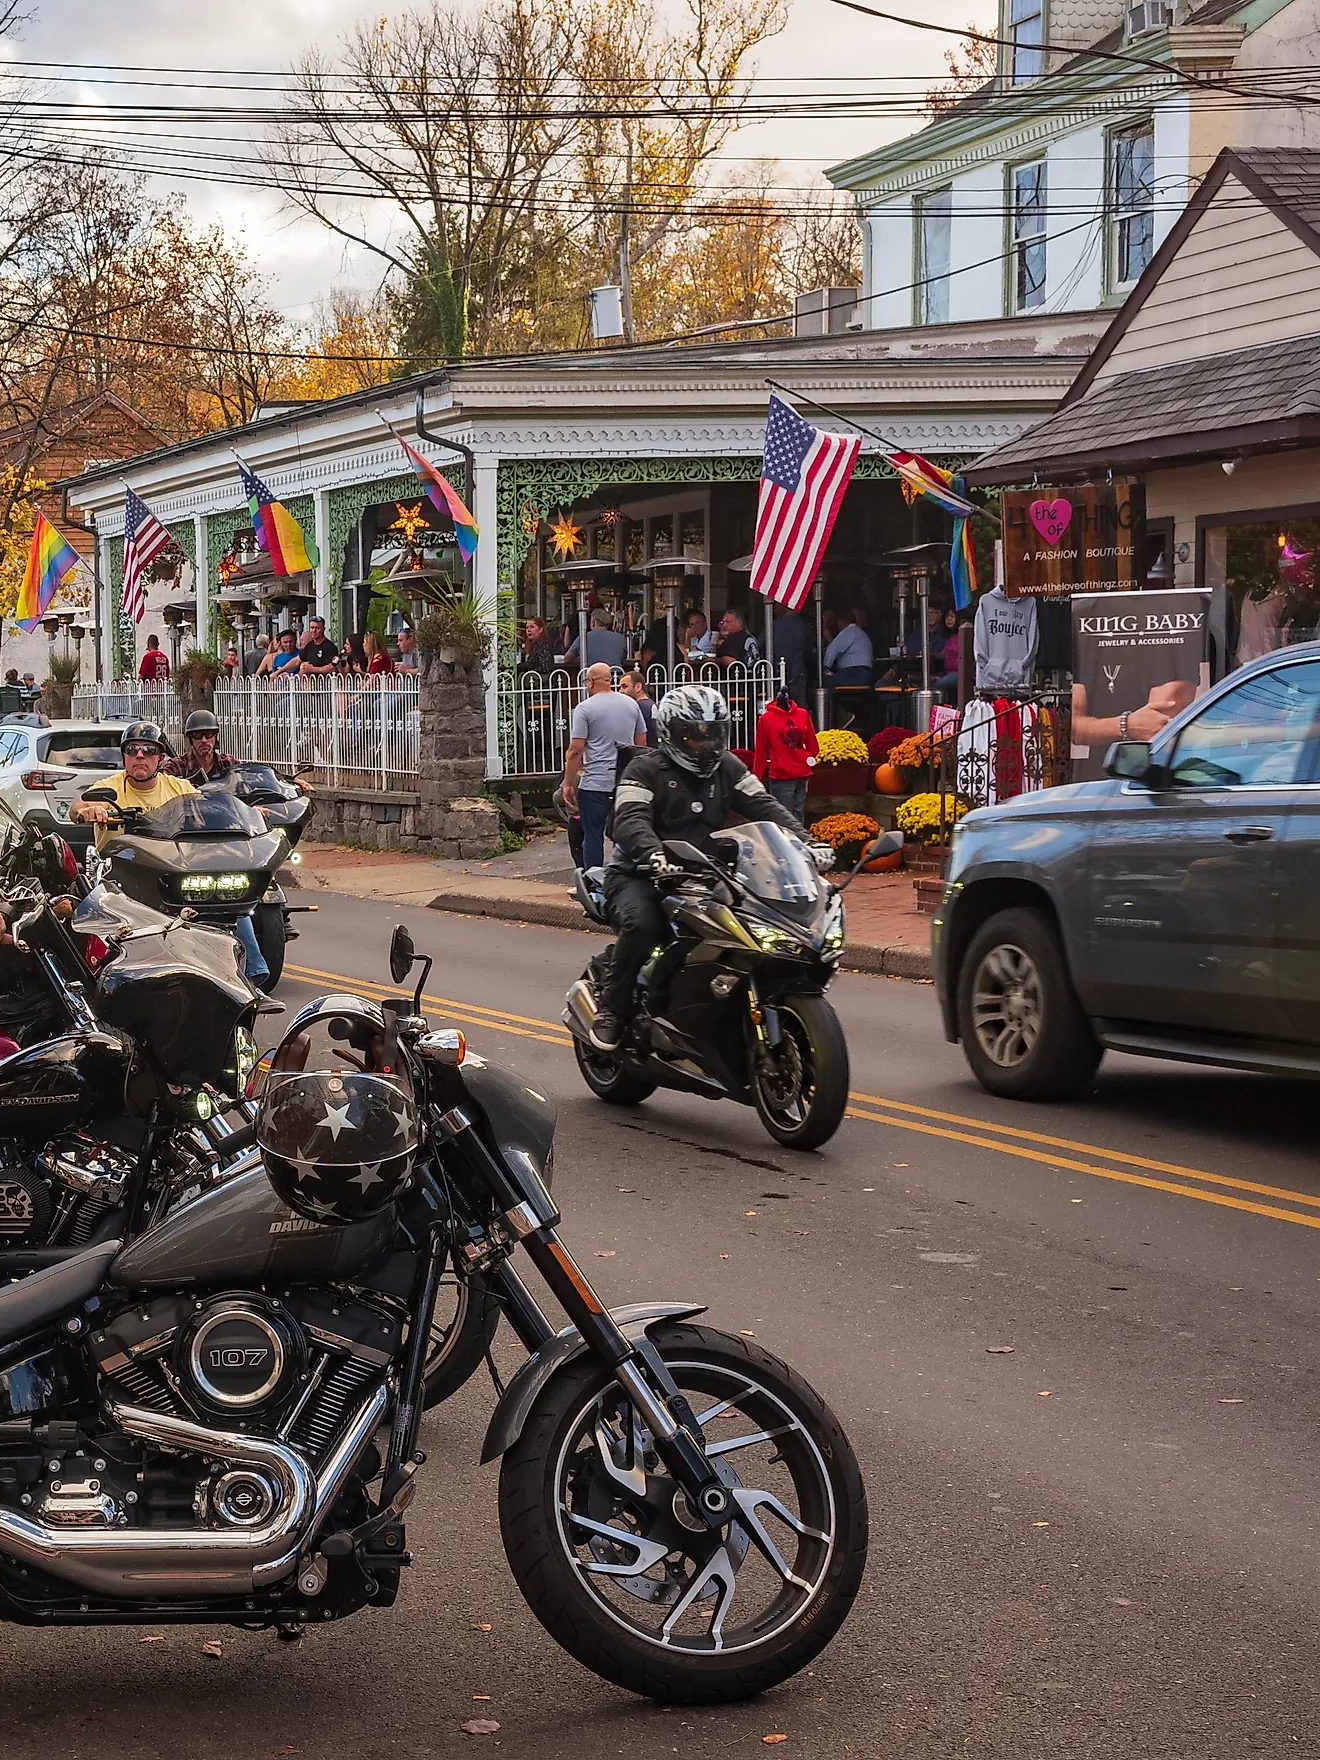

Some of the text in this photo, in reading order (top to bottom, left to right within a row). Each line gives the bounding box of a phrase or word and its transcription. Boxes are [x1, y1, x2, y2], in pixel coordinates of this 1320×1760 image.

[1035, 506, 1057, 520] the
[1047, 522, 1065, 536] of
[1023, 546, 1135, 561] A FASHION BOUTIQUE
[1018, 579, 1138, 594] www.4theloveofthingz.com
[1080, 612, 1204, 633] KING BABY
[1097, 636, 1184, 647] JEWELRY & ACCESSORIES
[210, 1349, 268, 1367] 107
